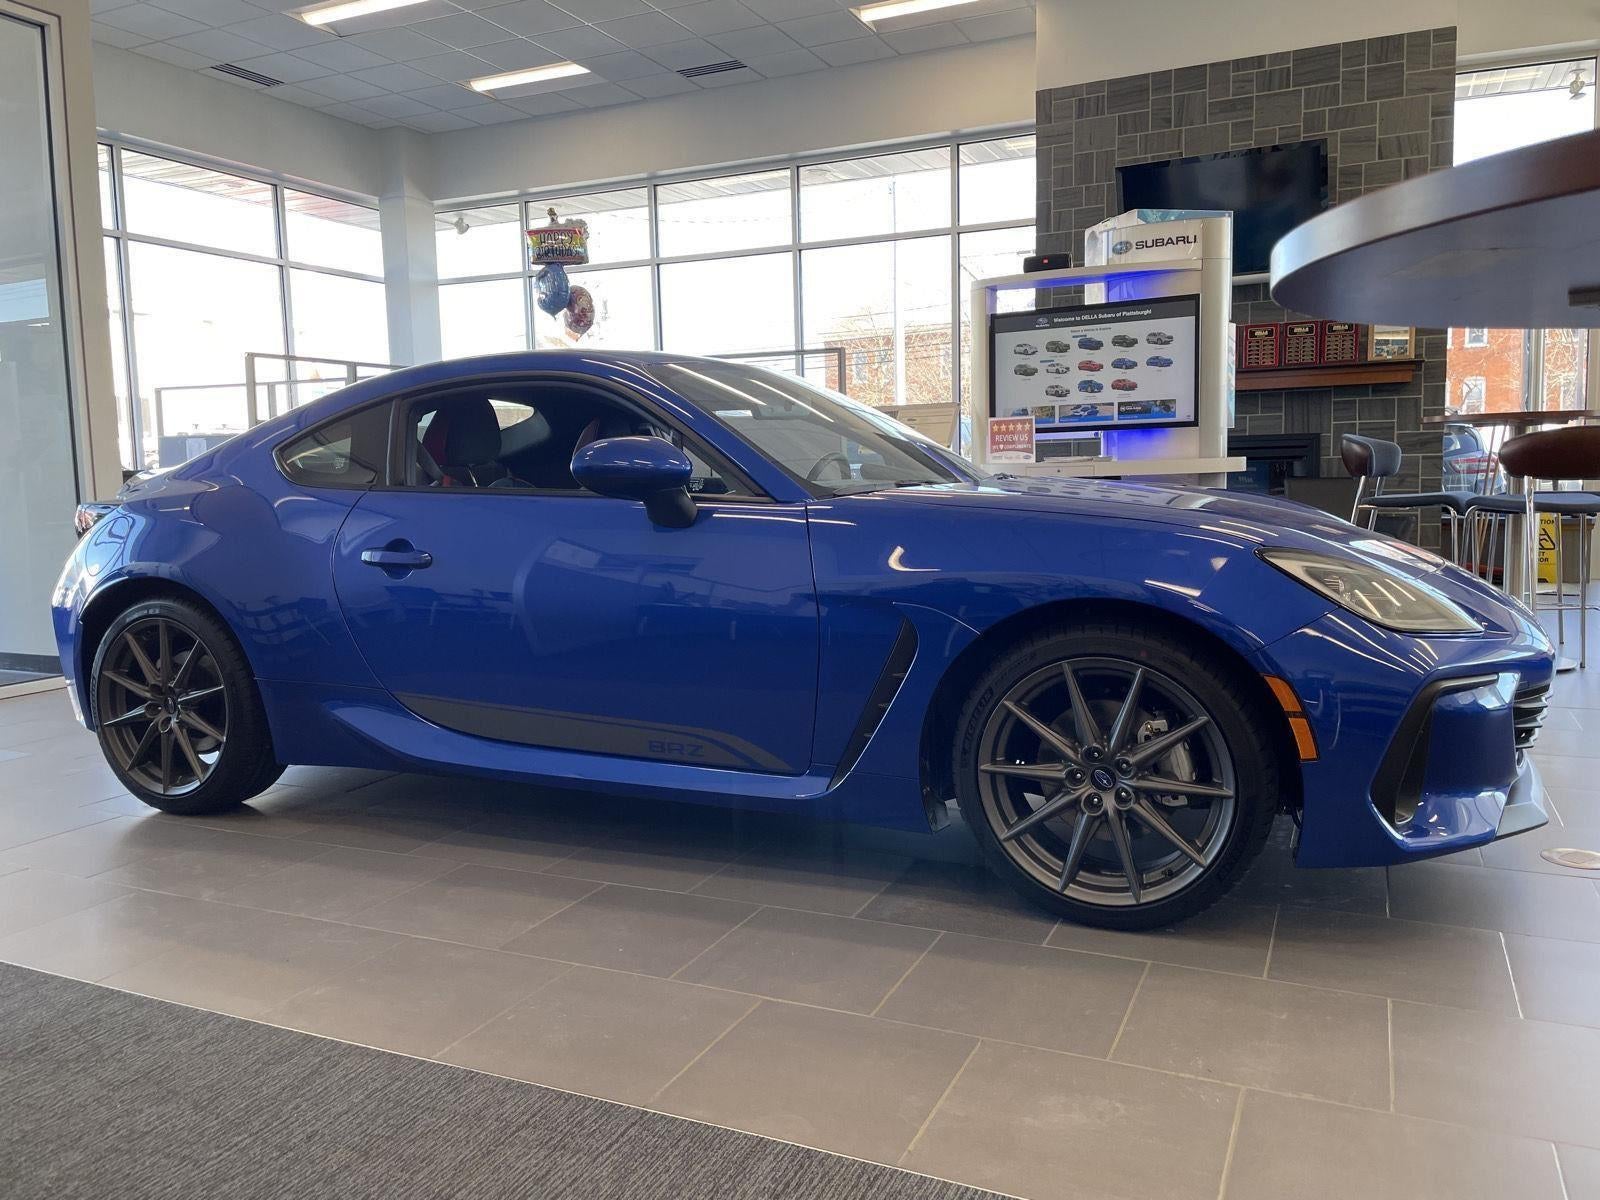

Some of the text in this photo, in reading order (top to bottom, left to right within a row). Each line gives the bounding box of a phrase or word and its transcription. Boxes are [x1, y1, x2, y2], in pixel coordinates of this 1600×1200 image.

[540, 232, 573, 245] HAPPY
[1135, 235, 1197, 250] SUBARU
[995, 433, 1029, 442] REVIEW US
[648, 740, 704, 757] BRZ
